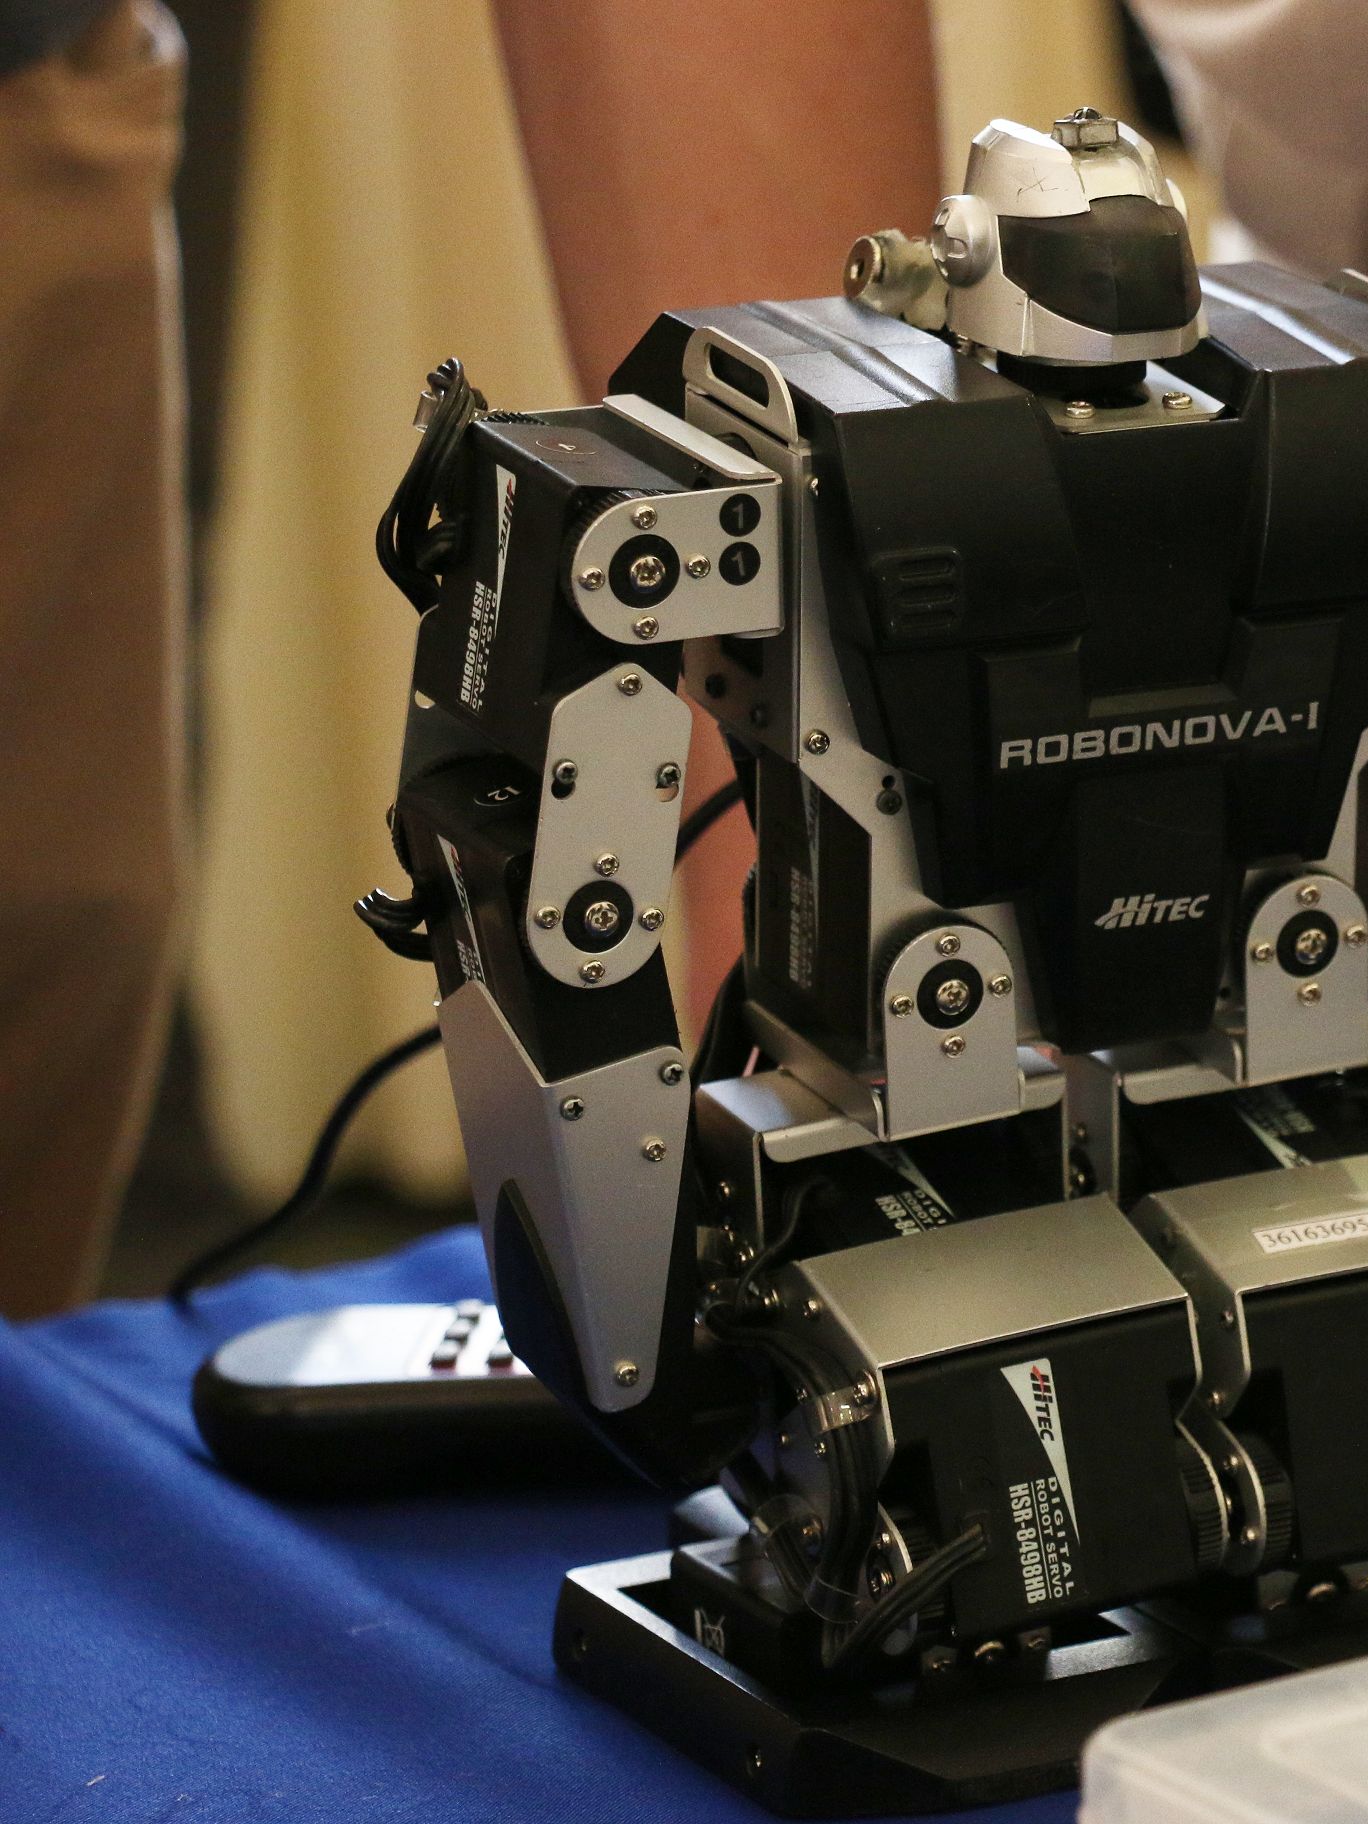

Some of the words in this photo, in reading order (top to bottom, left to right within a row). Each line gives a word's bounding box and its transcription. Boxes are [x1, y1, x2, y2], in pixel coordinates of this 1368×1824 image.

[730, 551, 746, 577] 1
[732, 503, 744, 529] 1
[460, 580, 485, 703] HSR-8498HB
[1008, 1482, 1047, 1604] HSR-8498HB
[1035, 1478, 1054, 1536] ROBOT
[1045, 1542, 1064, 1599] SERVO
[1048, 1476, 1075, 1596] DIGITAL
